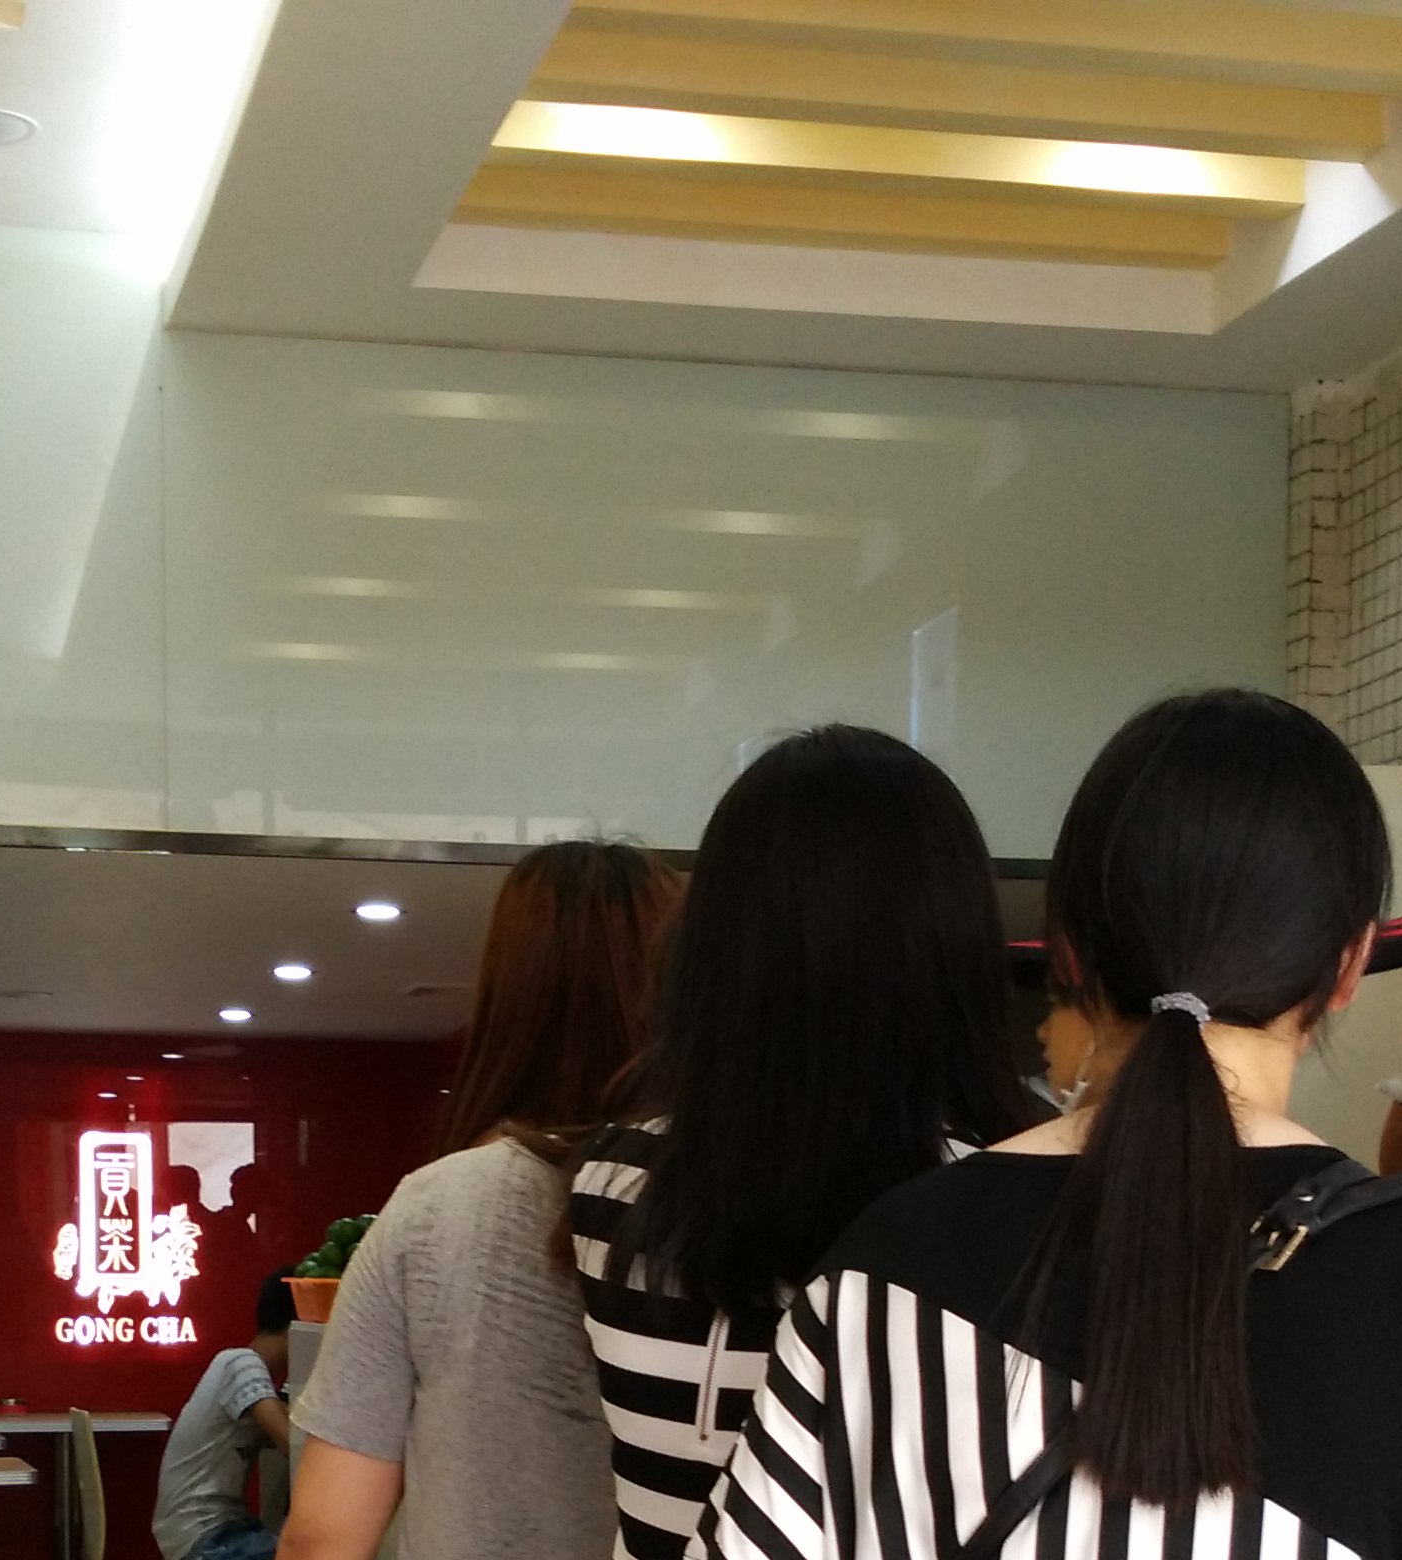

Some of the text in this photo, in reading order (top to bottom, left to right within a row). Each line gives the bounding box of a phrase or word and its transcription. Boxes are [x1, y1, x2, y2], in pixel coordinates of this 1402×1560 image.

[93, 1152, 136, 1272] 貢茶
[54, 1315, 198, 1346] GONG CHA
